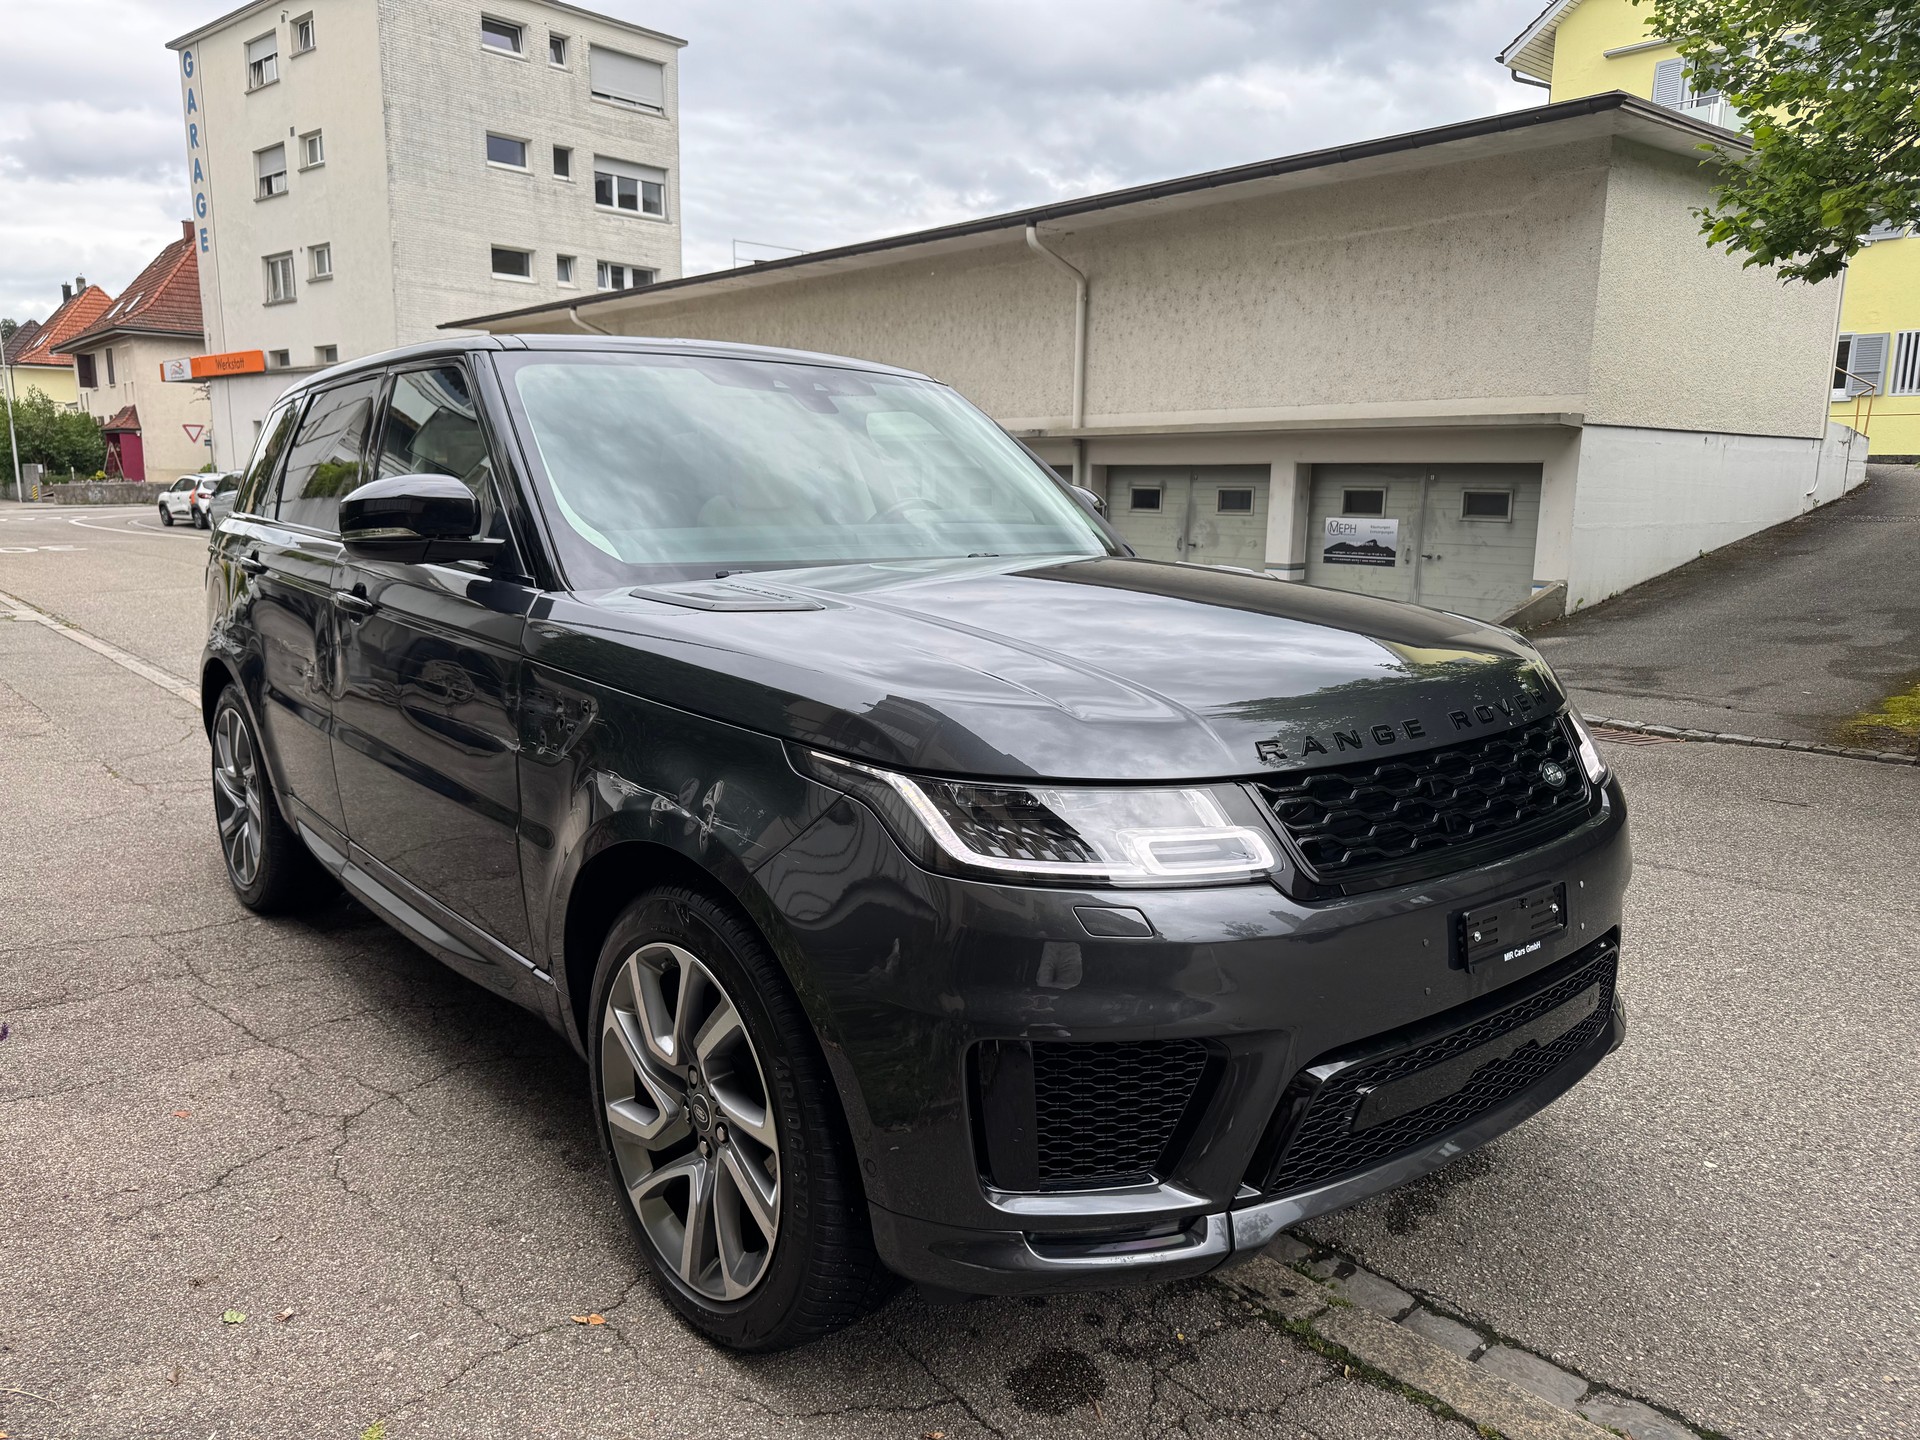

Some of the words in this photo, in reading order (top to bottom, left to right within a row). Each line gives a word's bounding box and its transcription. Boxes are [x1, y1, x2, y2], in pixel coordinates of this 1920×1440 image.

[183, 50, 209, 253] GARAGE
[214, 357, 245, 371] Werkstatt
[1254, 718, 1426, 763] RANGE
[1447, 688, 1548, 731] ROVER
[1514, 948, 1526, 958] Cars
[1526, 940, 1541, 953] GmbH
